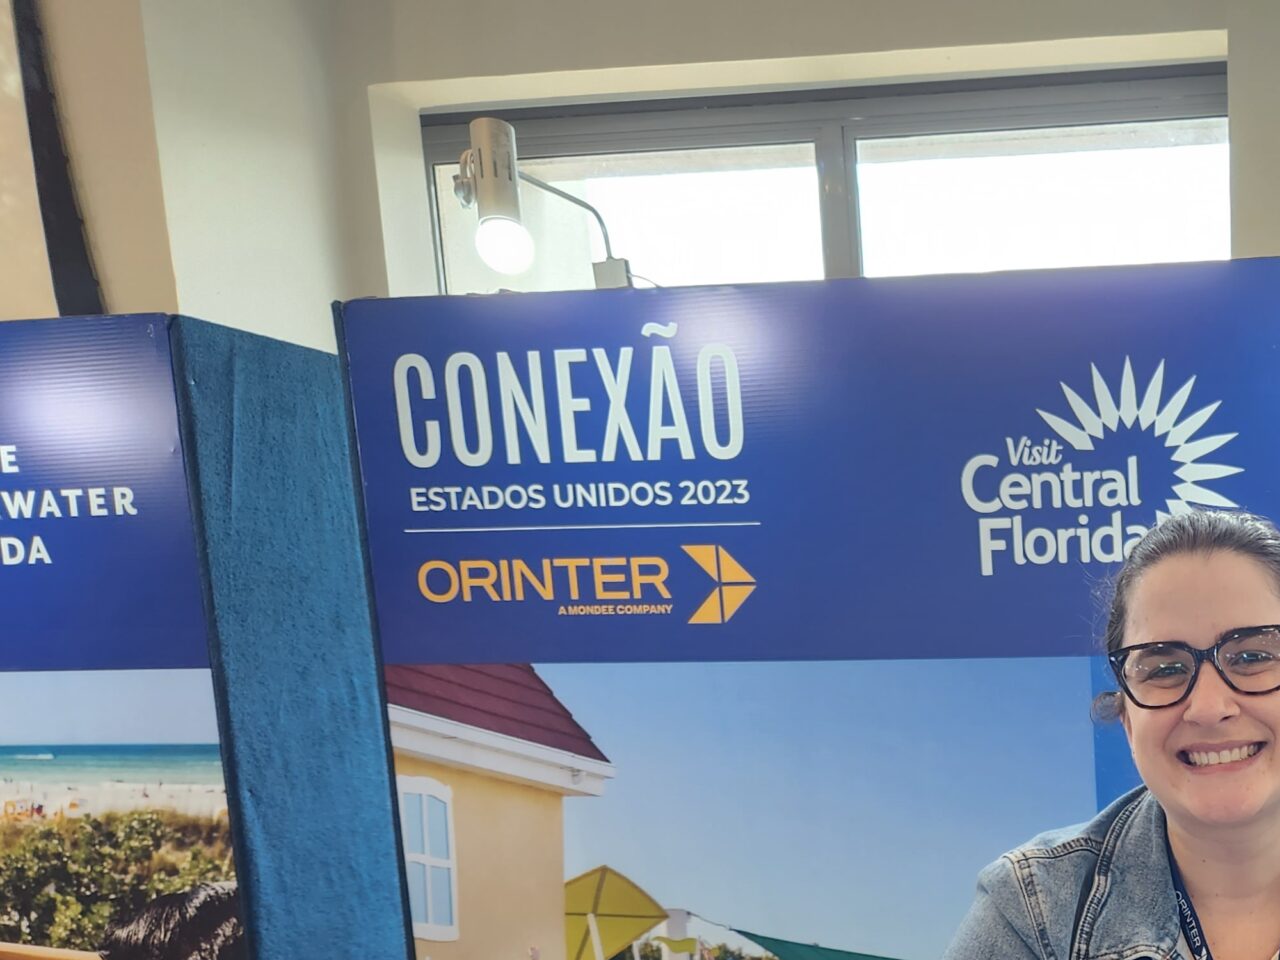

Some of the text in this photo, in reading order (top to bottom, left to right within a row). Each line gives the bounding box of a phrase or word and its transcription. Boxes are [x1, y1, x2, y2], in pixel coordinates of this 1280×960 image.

[393, 322, 744, 468] CONEXÃO
[1005, 436, 1063, 467] Visit
[0, 486, 138, 519] WATER
[410, 479, 750, 512] ESTADOS UNIDOS 2023
[961, 454, 1142, 514] Central
[417, 556, 672, 604] ORINTER
[558, 604, 673, 615] A MONDEE COMPANY
[1175, 891, 1201, 948] ORINTER
